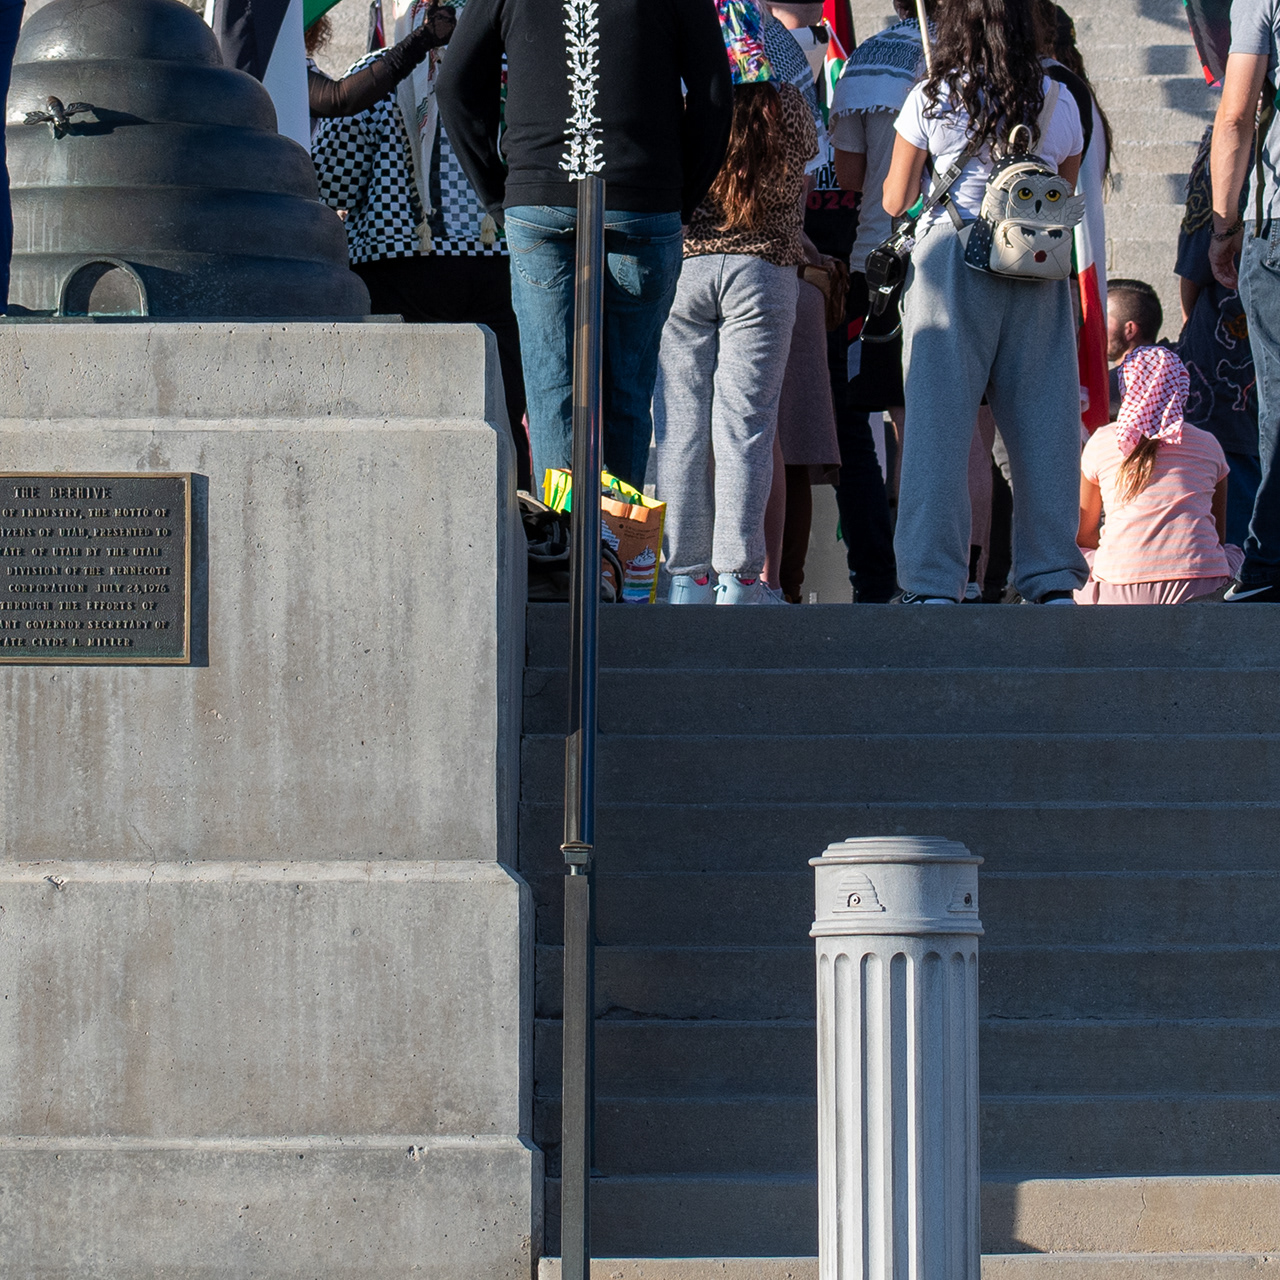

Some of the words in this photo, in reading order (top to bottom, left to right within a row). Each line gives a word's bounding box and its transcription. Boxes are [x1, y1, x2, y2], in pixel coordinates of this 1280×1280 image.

[806, 190, 856, 210] 024
[13, 486, 40, 499] THE
[50, 486, 111, 499] BEEHIVE
[2, 508, 18, 518] OF
[21, 508, 85, 520] INDUSTRY,
[88, 508, 110, 518] THE
[114, 508, 151, 518] MOTTO
[154, 508, 170, 518] OF
[38, 527, 53, 537] OF
[59, 527, 91, 539] UTAH,
[93, 527, 152, 537] PRESENTED
[155, 527, 170, 537] TO
[31, 547, 47, 557] OF
[52, 547, 81, 557] UTAH
[86, 547, 100, 557] BY
[106, 547, 128, 557] THE
[132, 547, 161, 557] UTAH
[6, 566, 61, 576] DIVISION
[65, 566, 80, 576] OF
[83, 566, 105, 576] THE
[109, 566, 170, 576] KENNECOTT
[8, 583, 86, 593] CORPORATION
[95, 583, 123, 593] JULY
[0, 601, 53, 611] THROUGH
[58, 601, 81, 611] THE
[86, 601, 135, 611] EFFORTS
[141, 601, 157, 611] OF
[25, 620, 83, 630] GOVERNOR
[88, 620, 151, 630] SECRETARY
[154, 620, 169, 630] OF
[31, 637, 67, 647] CLYDE
[87, 637, 132, 647] MILLER
